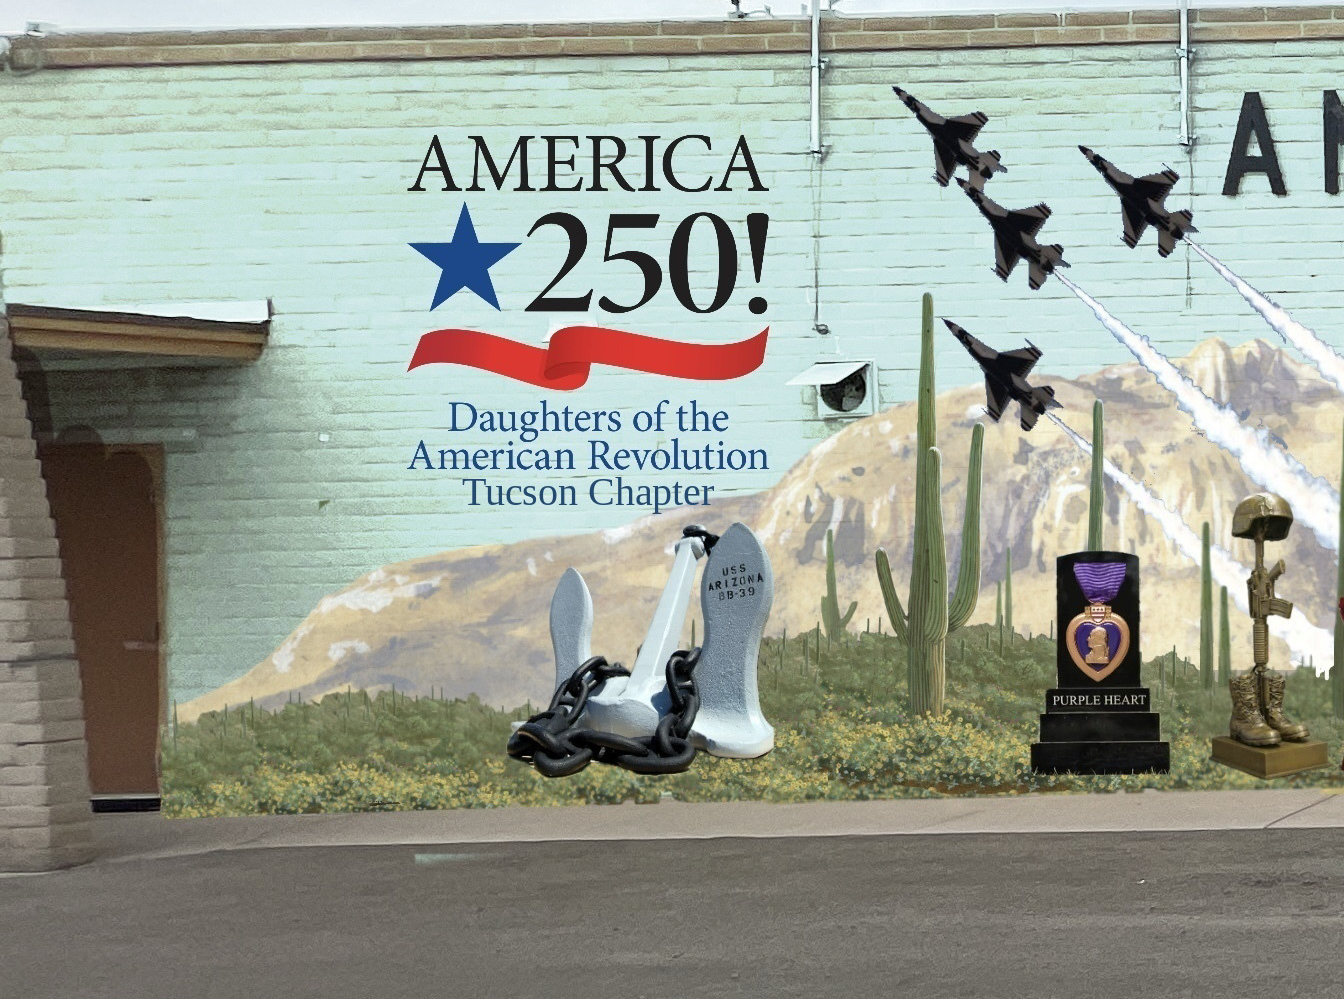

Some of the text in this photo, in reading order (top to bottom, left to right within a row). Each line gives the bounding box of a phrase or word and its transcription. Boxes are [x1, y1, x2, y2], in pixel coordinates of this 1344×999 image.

[407, 134, 770, 192] AMERICA
[524, 212, 770, 315] 250!
[447, 399, 730, 442] Daughters of the
[407, 438, 770, 471] American Revolution
[462, 476, 715, 515] Tucson Chapter
[708, 572, 764, 592] ARIZONA
[722, 563, 746, 577] USS
[718, 586, 755, 601] BB-39
[1053, 694, 1147, 706] PURPLE HEART
